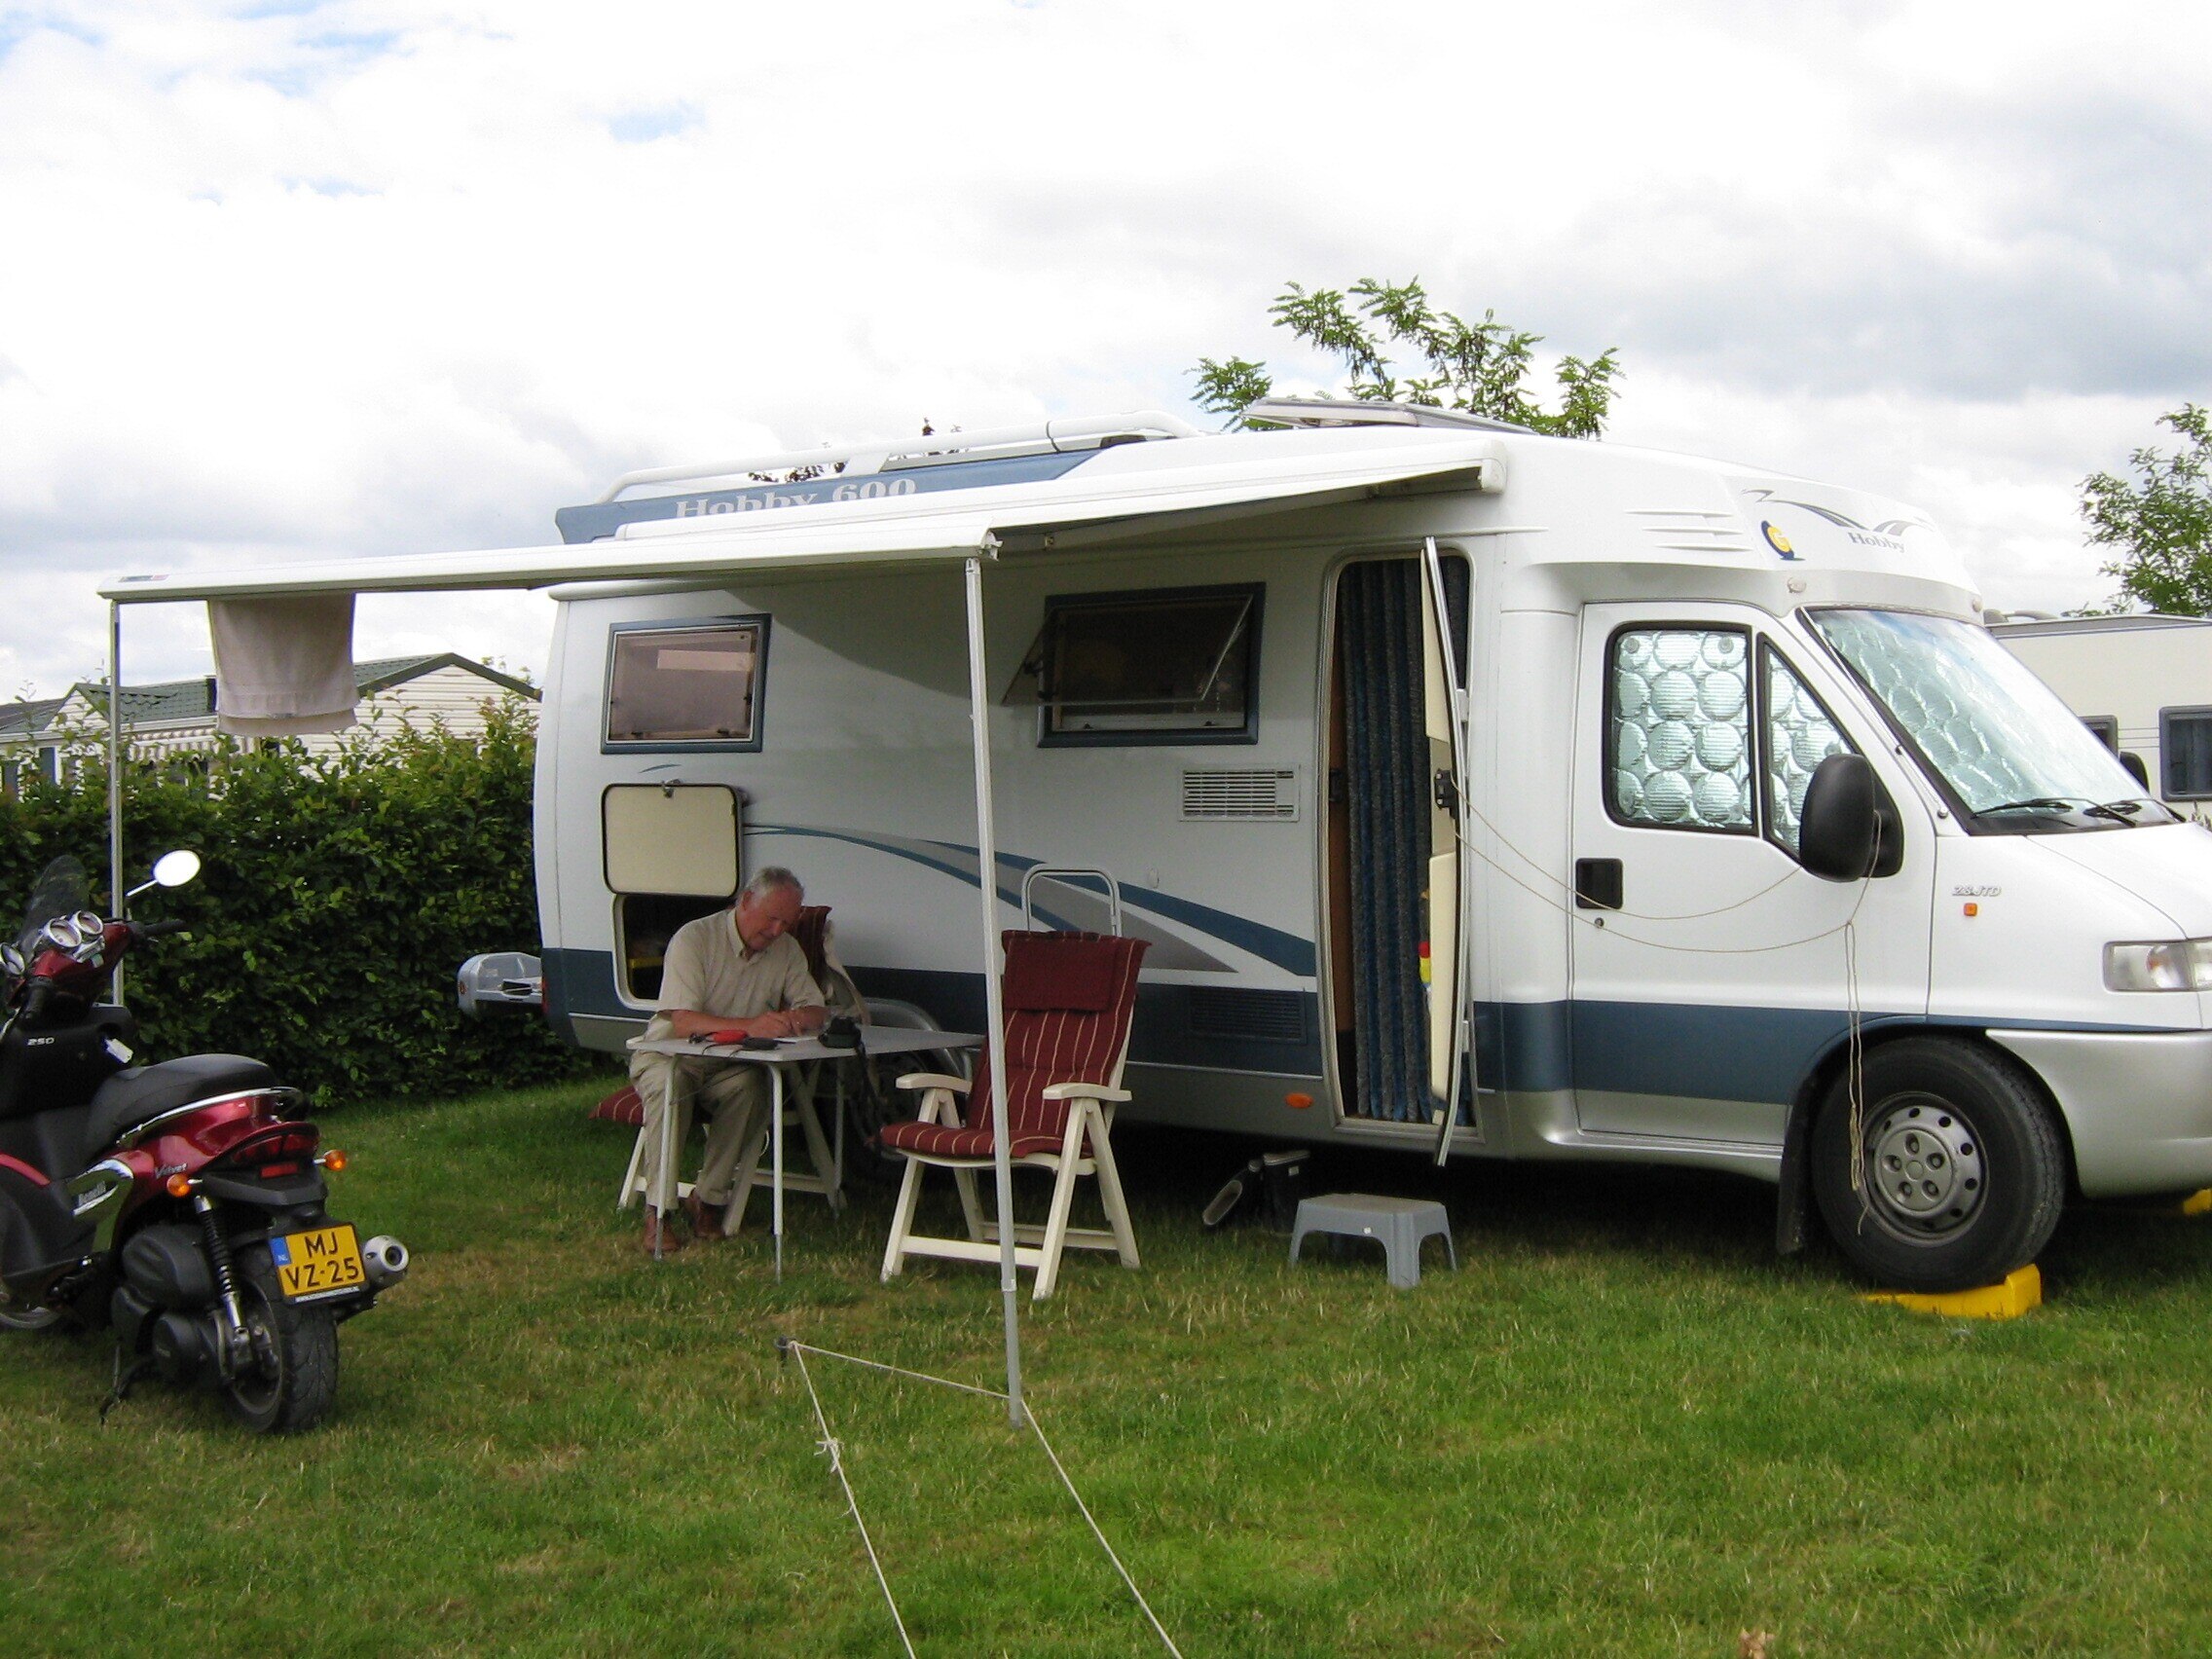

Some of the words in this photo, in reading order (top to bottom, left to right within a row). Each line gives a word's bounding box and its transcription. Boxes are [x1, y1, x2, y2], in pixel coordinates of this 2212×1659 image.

[833, 479, 915, 502] 600
[1848, 532, 1905, 553] Hobby
[304, 1232, 338, 1258] MJ
